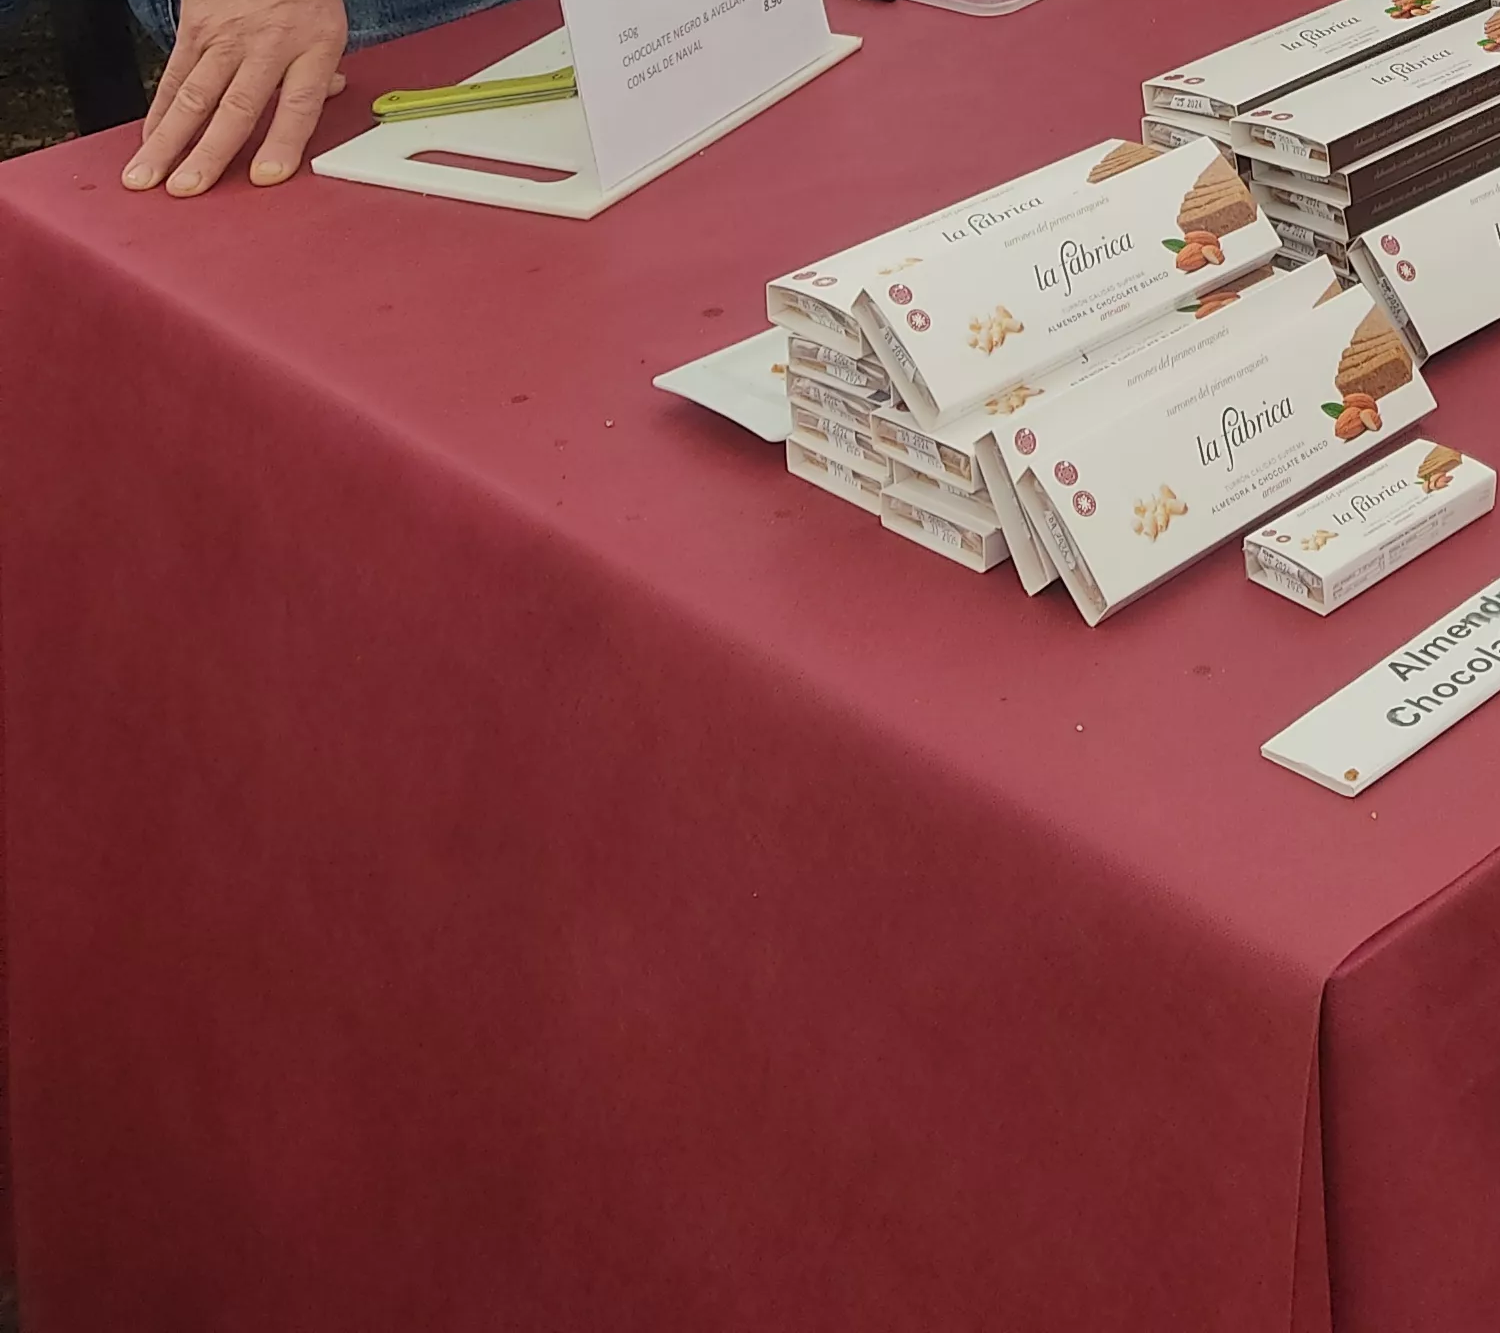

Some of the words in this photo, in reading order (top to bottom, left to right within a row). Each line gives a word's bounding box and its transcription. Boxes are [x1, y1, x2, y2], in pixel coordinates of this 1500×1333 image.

[618, 26, 639, 45] 150g
[622, 32, 672, 67] CHOCOLATE
[673, 16, 701, 40] NEGRO
[703, 12, 709, 23] &
[627, 72, 646, 90] CON
[647, 63, 662, 79] SAL
[663, 55, 674, 71] DE
[675, 39, 703, 62] NAVAL
[942, 230, 968, 243] la
[1004, 229, 1036, 248] turrones
[1036, 221, 1049, 234] del
[1049, 213, 1076, 231] pirineo
[1033, 263, 1059, 292] la
[1048, 310, 1087, 334] ALMENDRA
[1089, 305, 1095, 314] &
[1096, 287, 1139, 311] CHOCOLATE
[1140, 271, 1169, 291] BLANCO
[1099, 302, 1131, 322] artesano
[1127, 366, 1157, 387] turrones
[1159, 355, 1170, 372] del
[1171, 347, 1196, 368] pirineo
[1197, 327, 1229, 353] aragonés
[1167, 396, 1198, 417] turrones
[1198, 387, 1210, 401] del
[1210, 376, 1236, 397] pirineo
[1237, 355, 1269, 378] aragonés
[1197, 435, 1221, 466] la
[1211, 488, 1250, 515] ALMENDRA
[1258, 457, 1300, 486] CHOCOLATE
[1301, 440, 1328, 462] BLANCO
[1262, 476, 1292, 499] artesano
[1332, 512, 1353, 527] la
